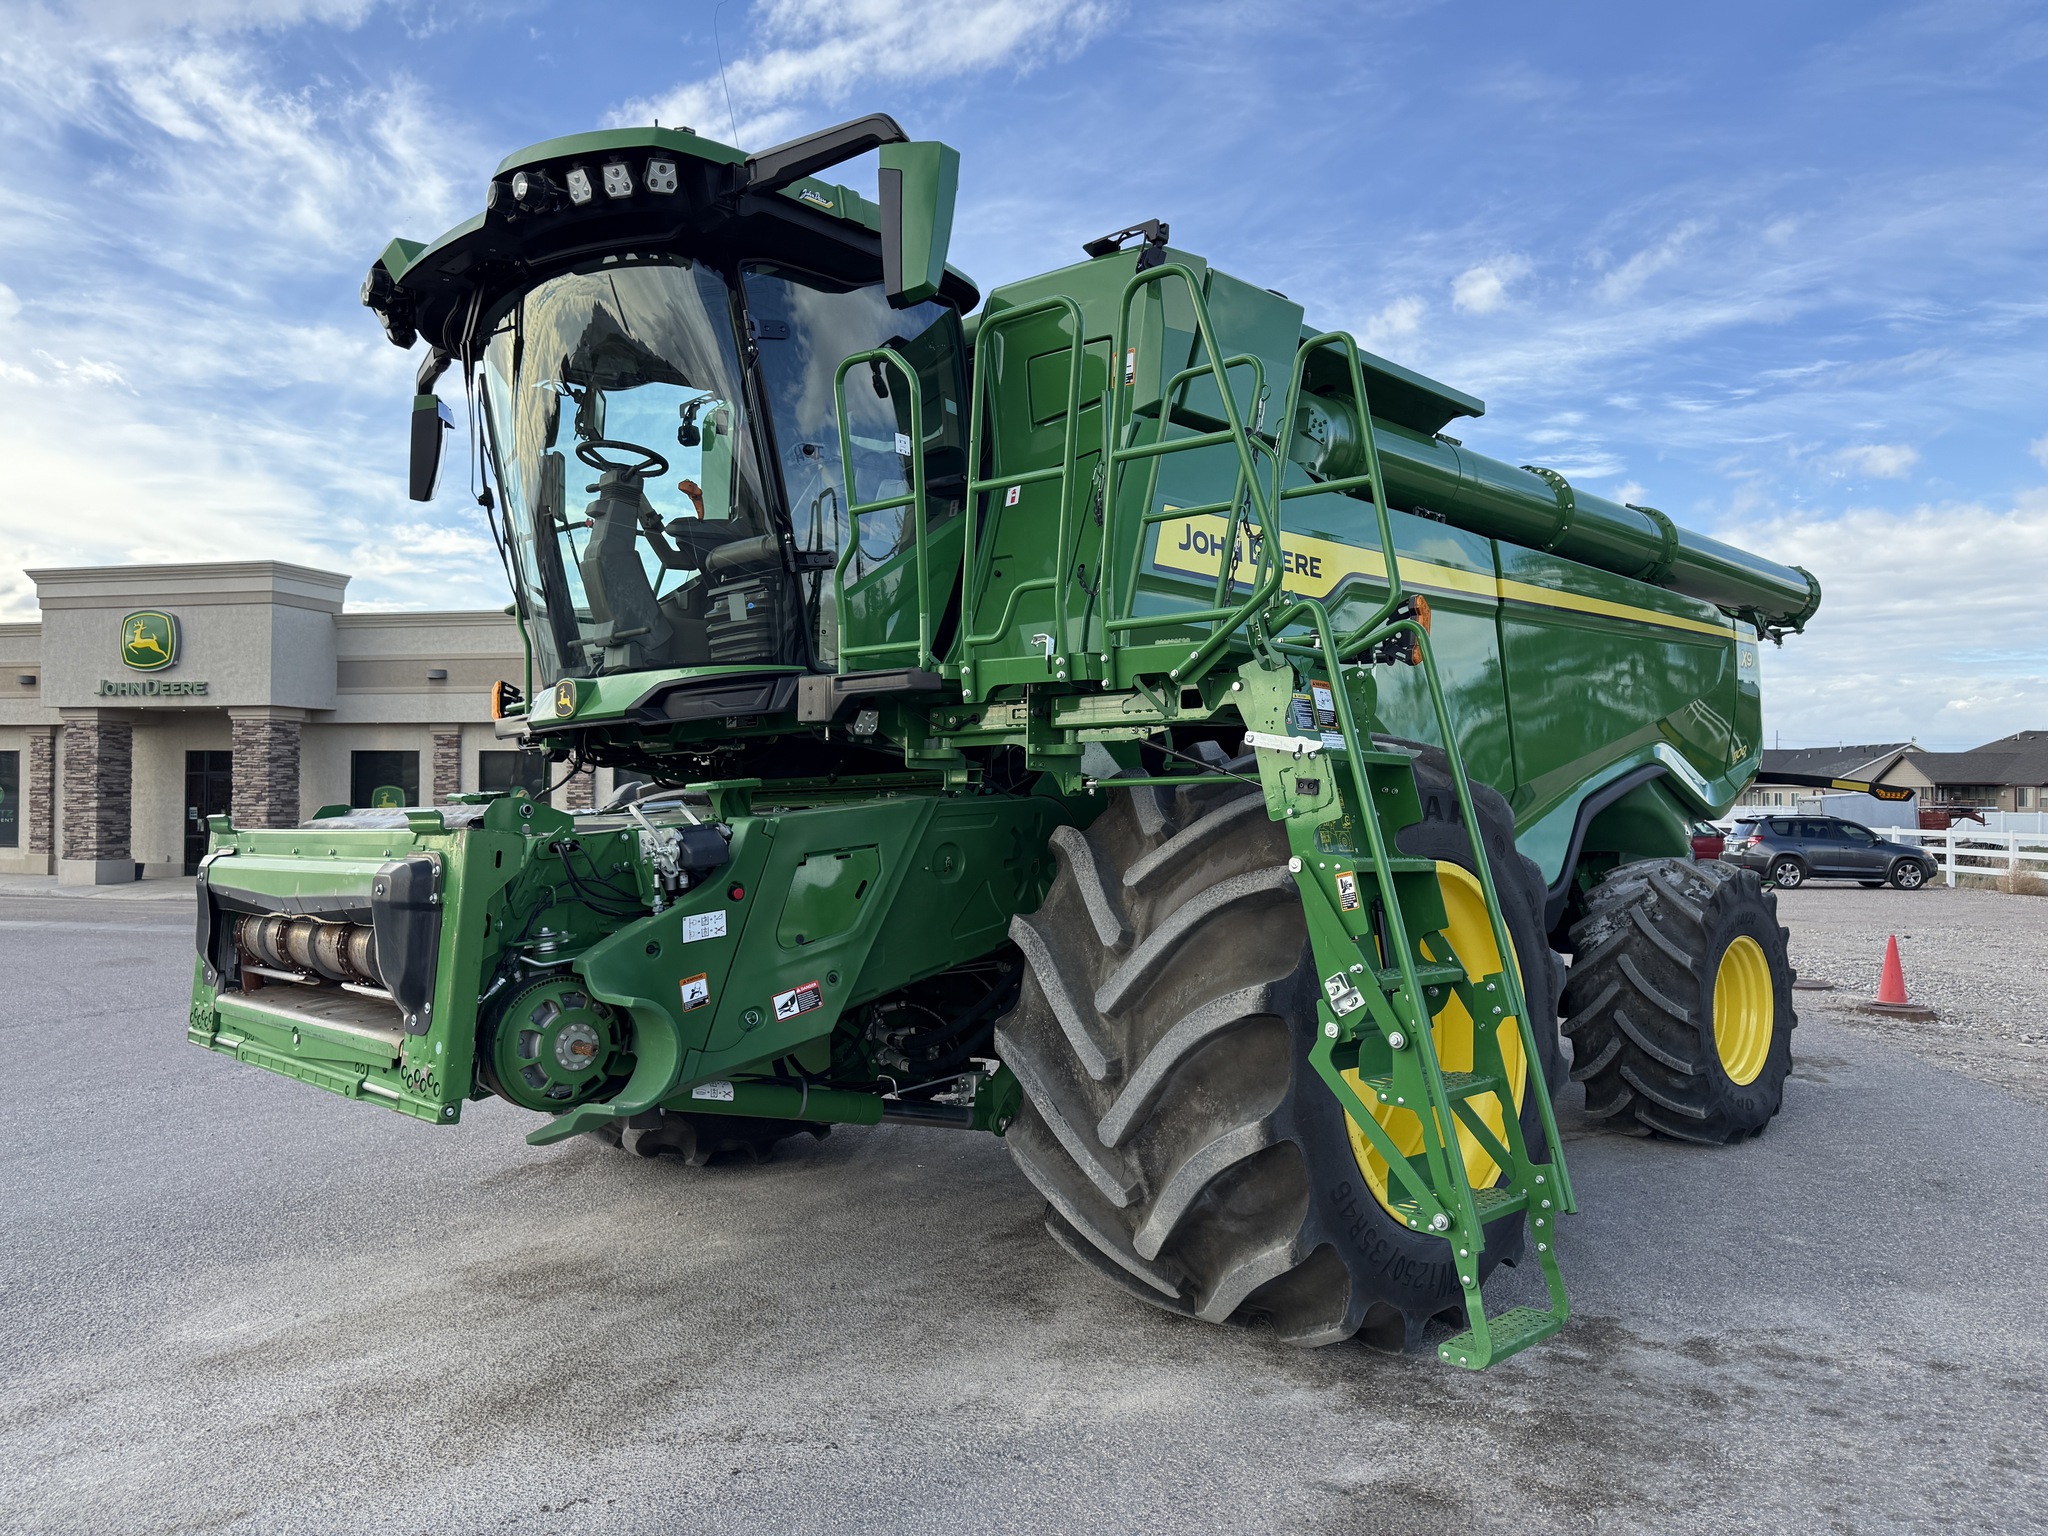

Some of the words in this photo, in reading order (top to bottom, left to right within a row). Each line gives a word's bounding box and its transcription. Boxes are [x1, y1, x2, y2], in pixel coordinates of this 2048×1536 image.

[1249, 538, 1322, 579] DERE
[1741, 649, 1753, 669] X9
[94, 680, 142, 697] JOHN
[145, 679, 207, 696] DEERE
